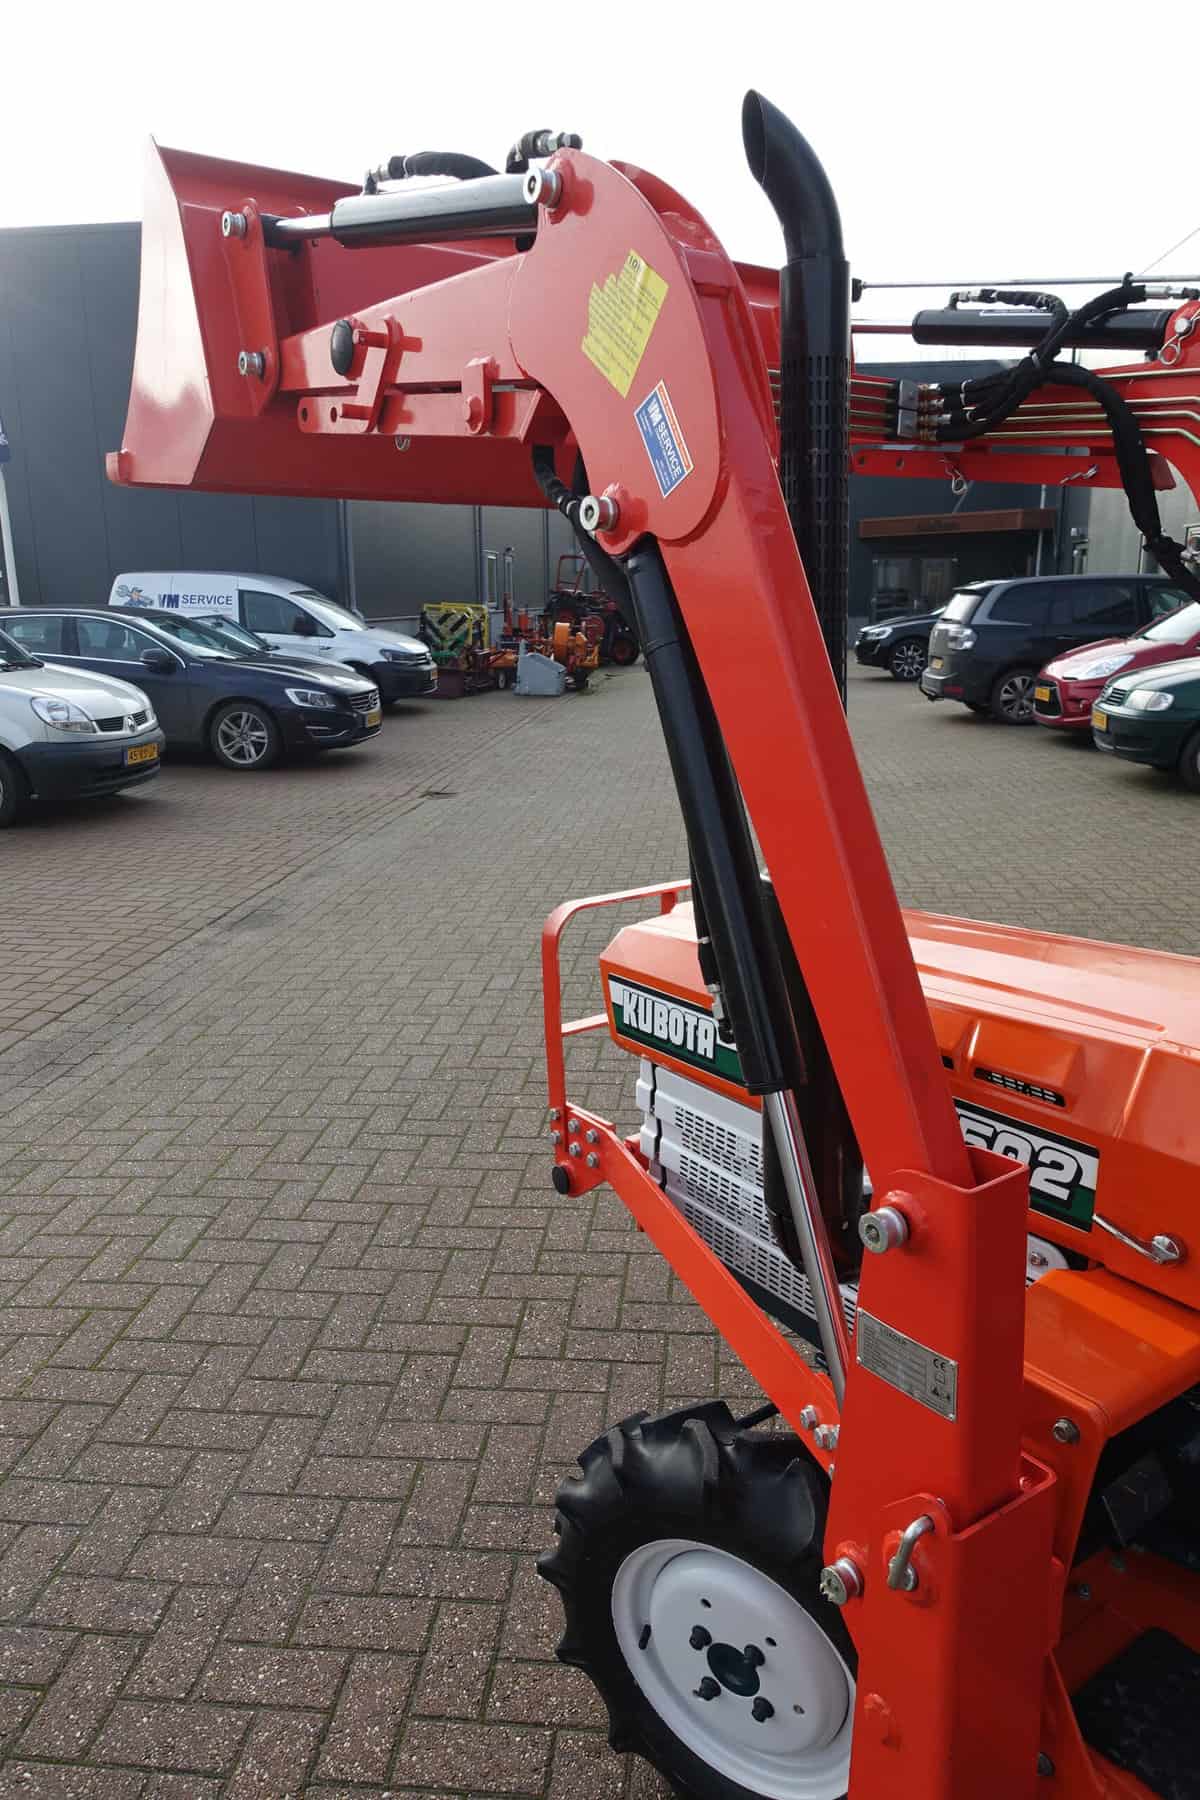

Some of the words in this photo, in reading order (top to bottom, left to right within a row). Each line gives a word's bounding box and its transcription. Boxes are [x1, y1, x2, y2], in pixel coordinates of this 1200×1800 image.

[657, 421, 682, 479] SERVICE
[181, 594, 233, 606] SERVICE
[622, 989, 716, 1061] KUBOTA
